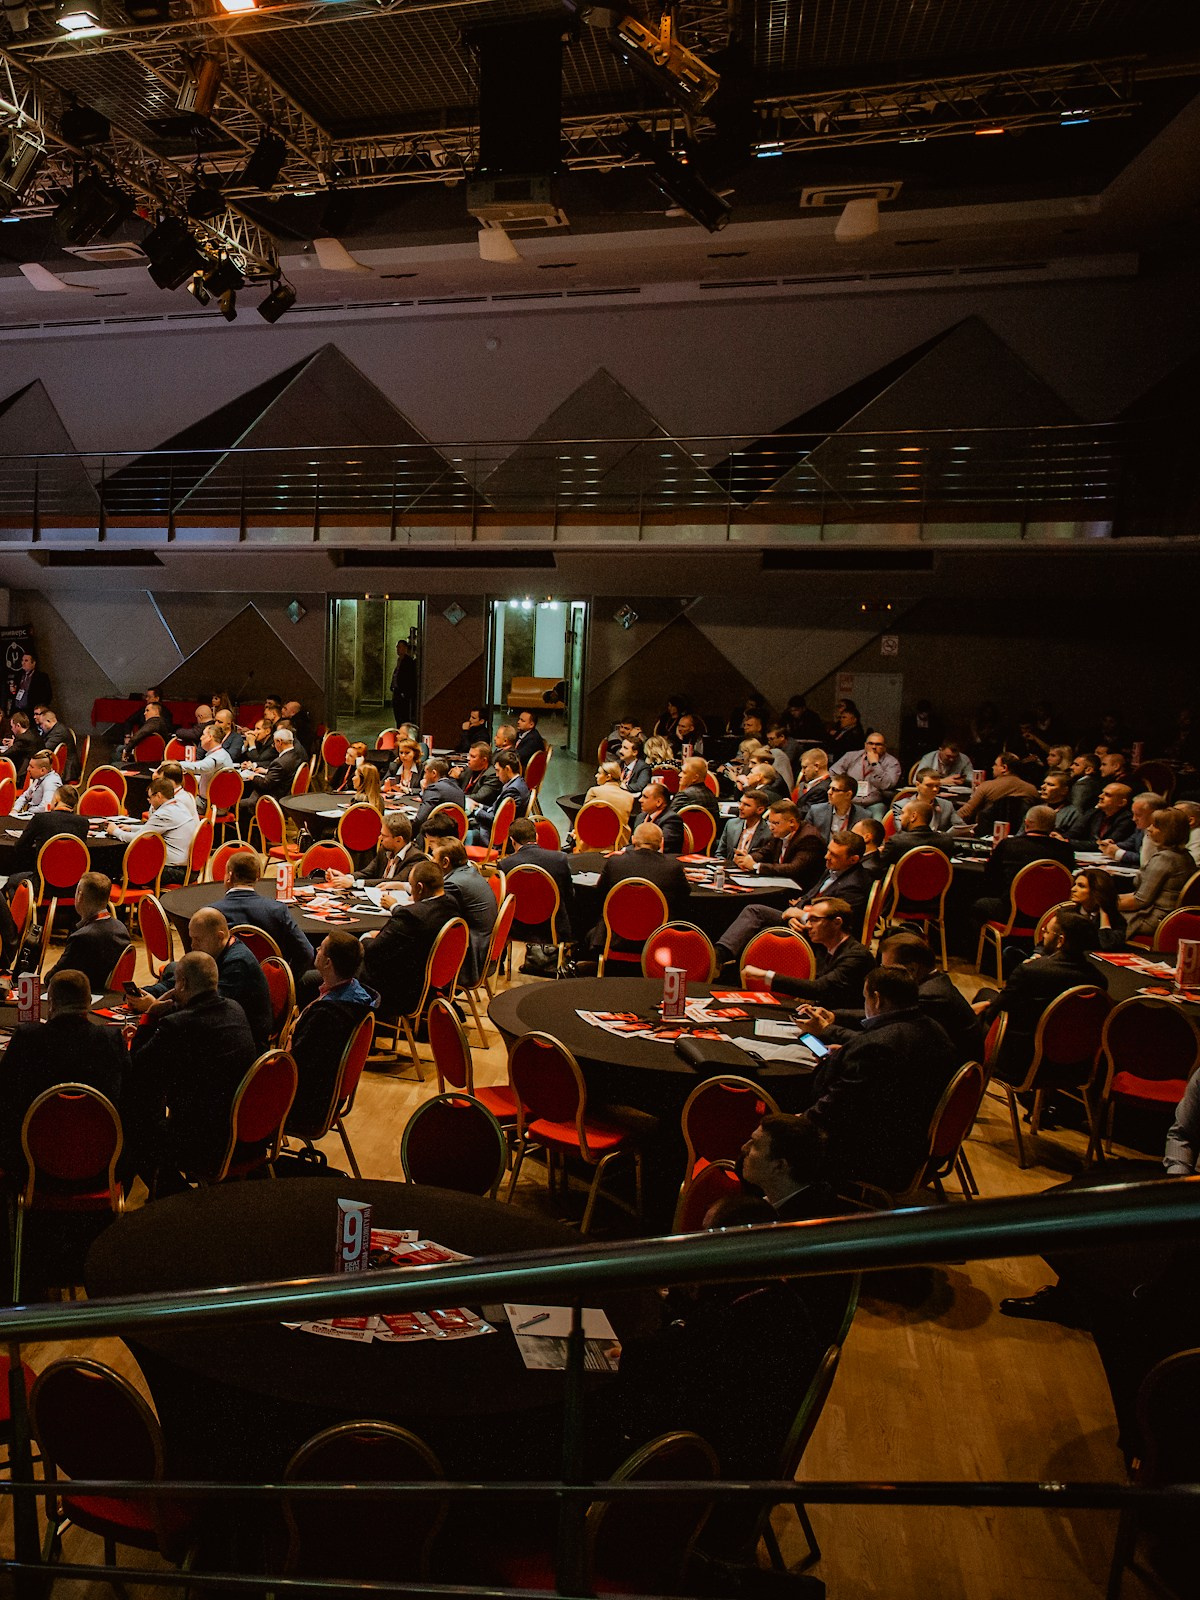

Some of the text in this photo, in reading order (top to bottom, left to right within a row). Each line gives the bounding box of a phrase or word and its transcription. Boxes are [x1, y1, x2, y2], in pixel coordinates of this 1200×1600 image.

[276, 865, 287, 890] 9
[18, 977, 32, 1010] 9
[664, 972, 679, 1004] 9
[343, 1210, 363, 1261] 9
[361, 1208, 371, 1271] ORUM-SECURITY.RU
